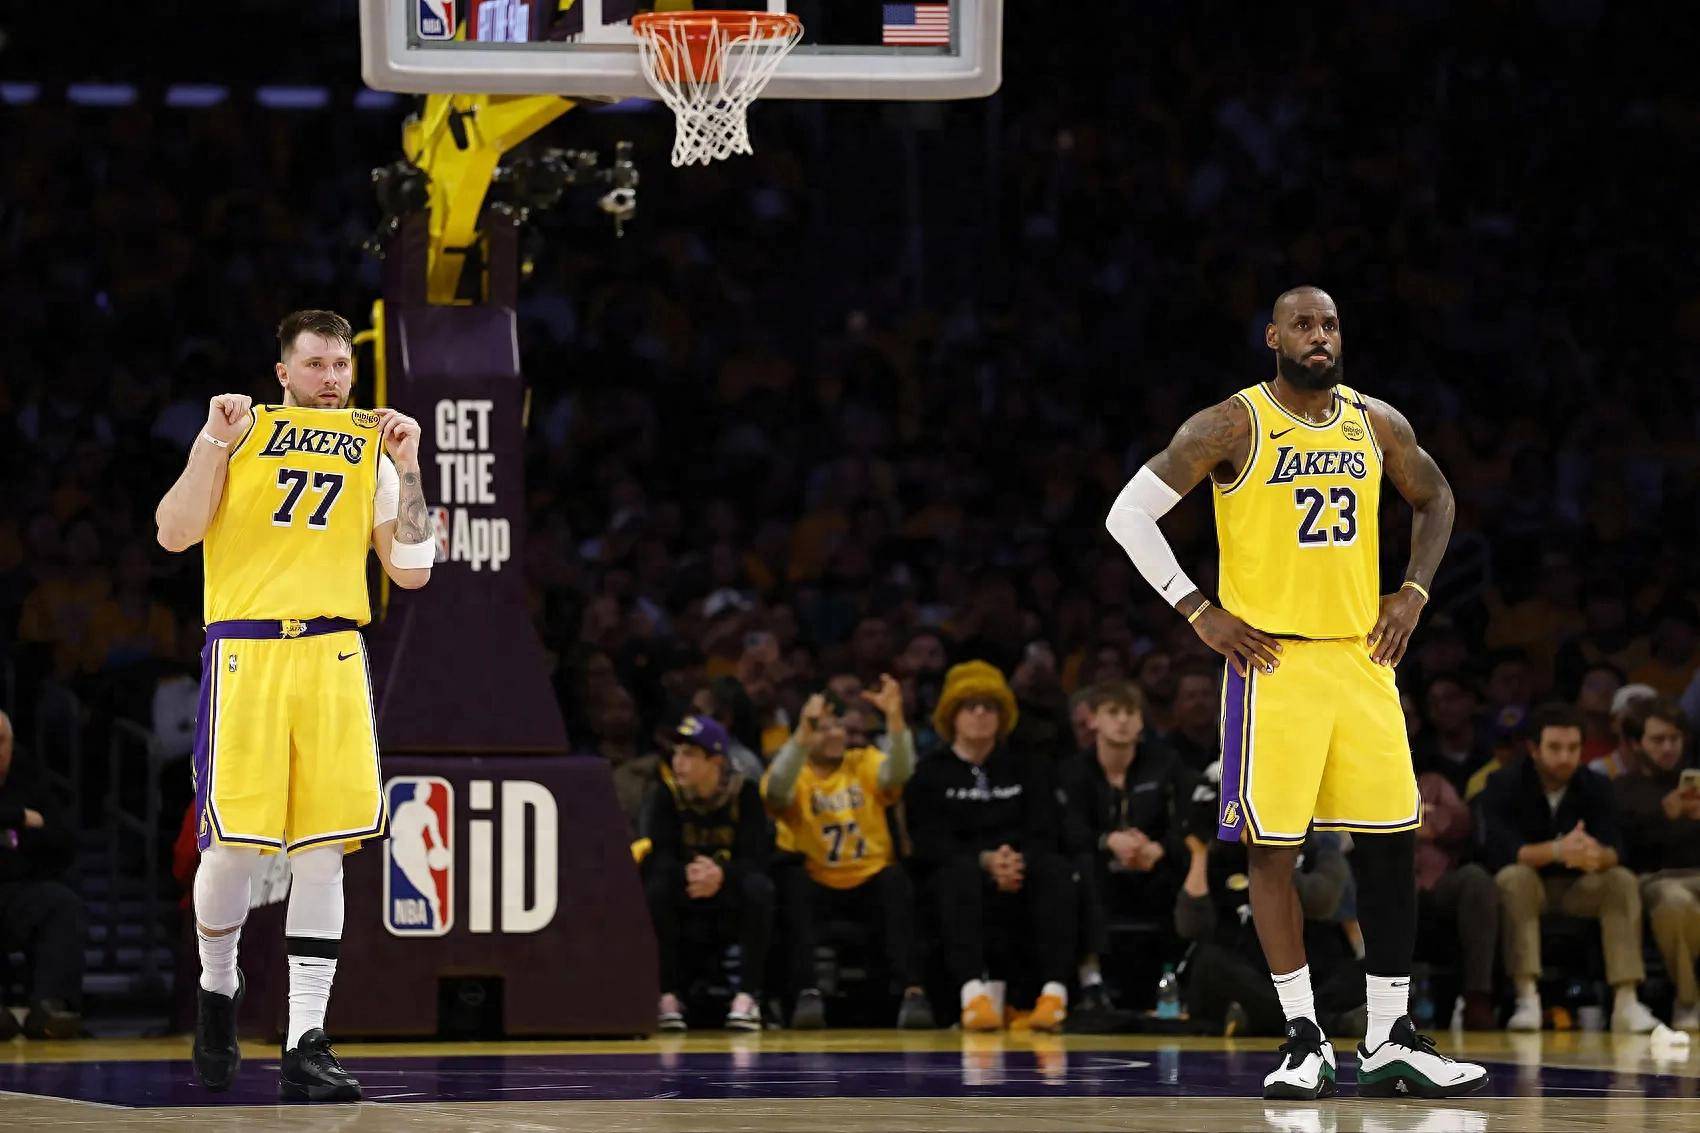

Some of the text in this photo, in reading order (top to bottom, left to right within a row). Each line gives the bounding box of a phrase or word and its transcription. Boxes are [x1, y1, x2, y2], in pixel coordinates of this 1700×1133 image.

[257, 420, 366, 465] LAKERS
[435, 399, 494, 451] GET
[435, 453, 496, 504] THE
[1266, 446, 1367, 485] LAKERS
[273, 468, 344, 530] 77
[1294, 486, 1358, 549] 23
[451, 507, 511, 572] App
[469, 779, 558, 934] iD
[394, 898, 428, 926] NBA
